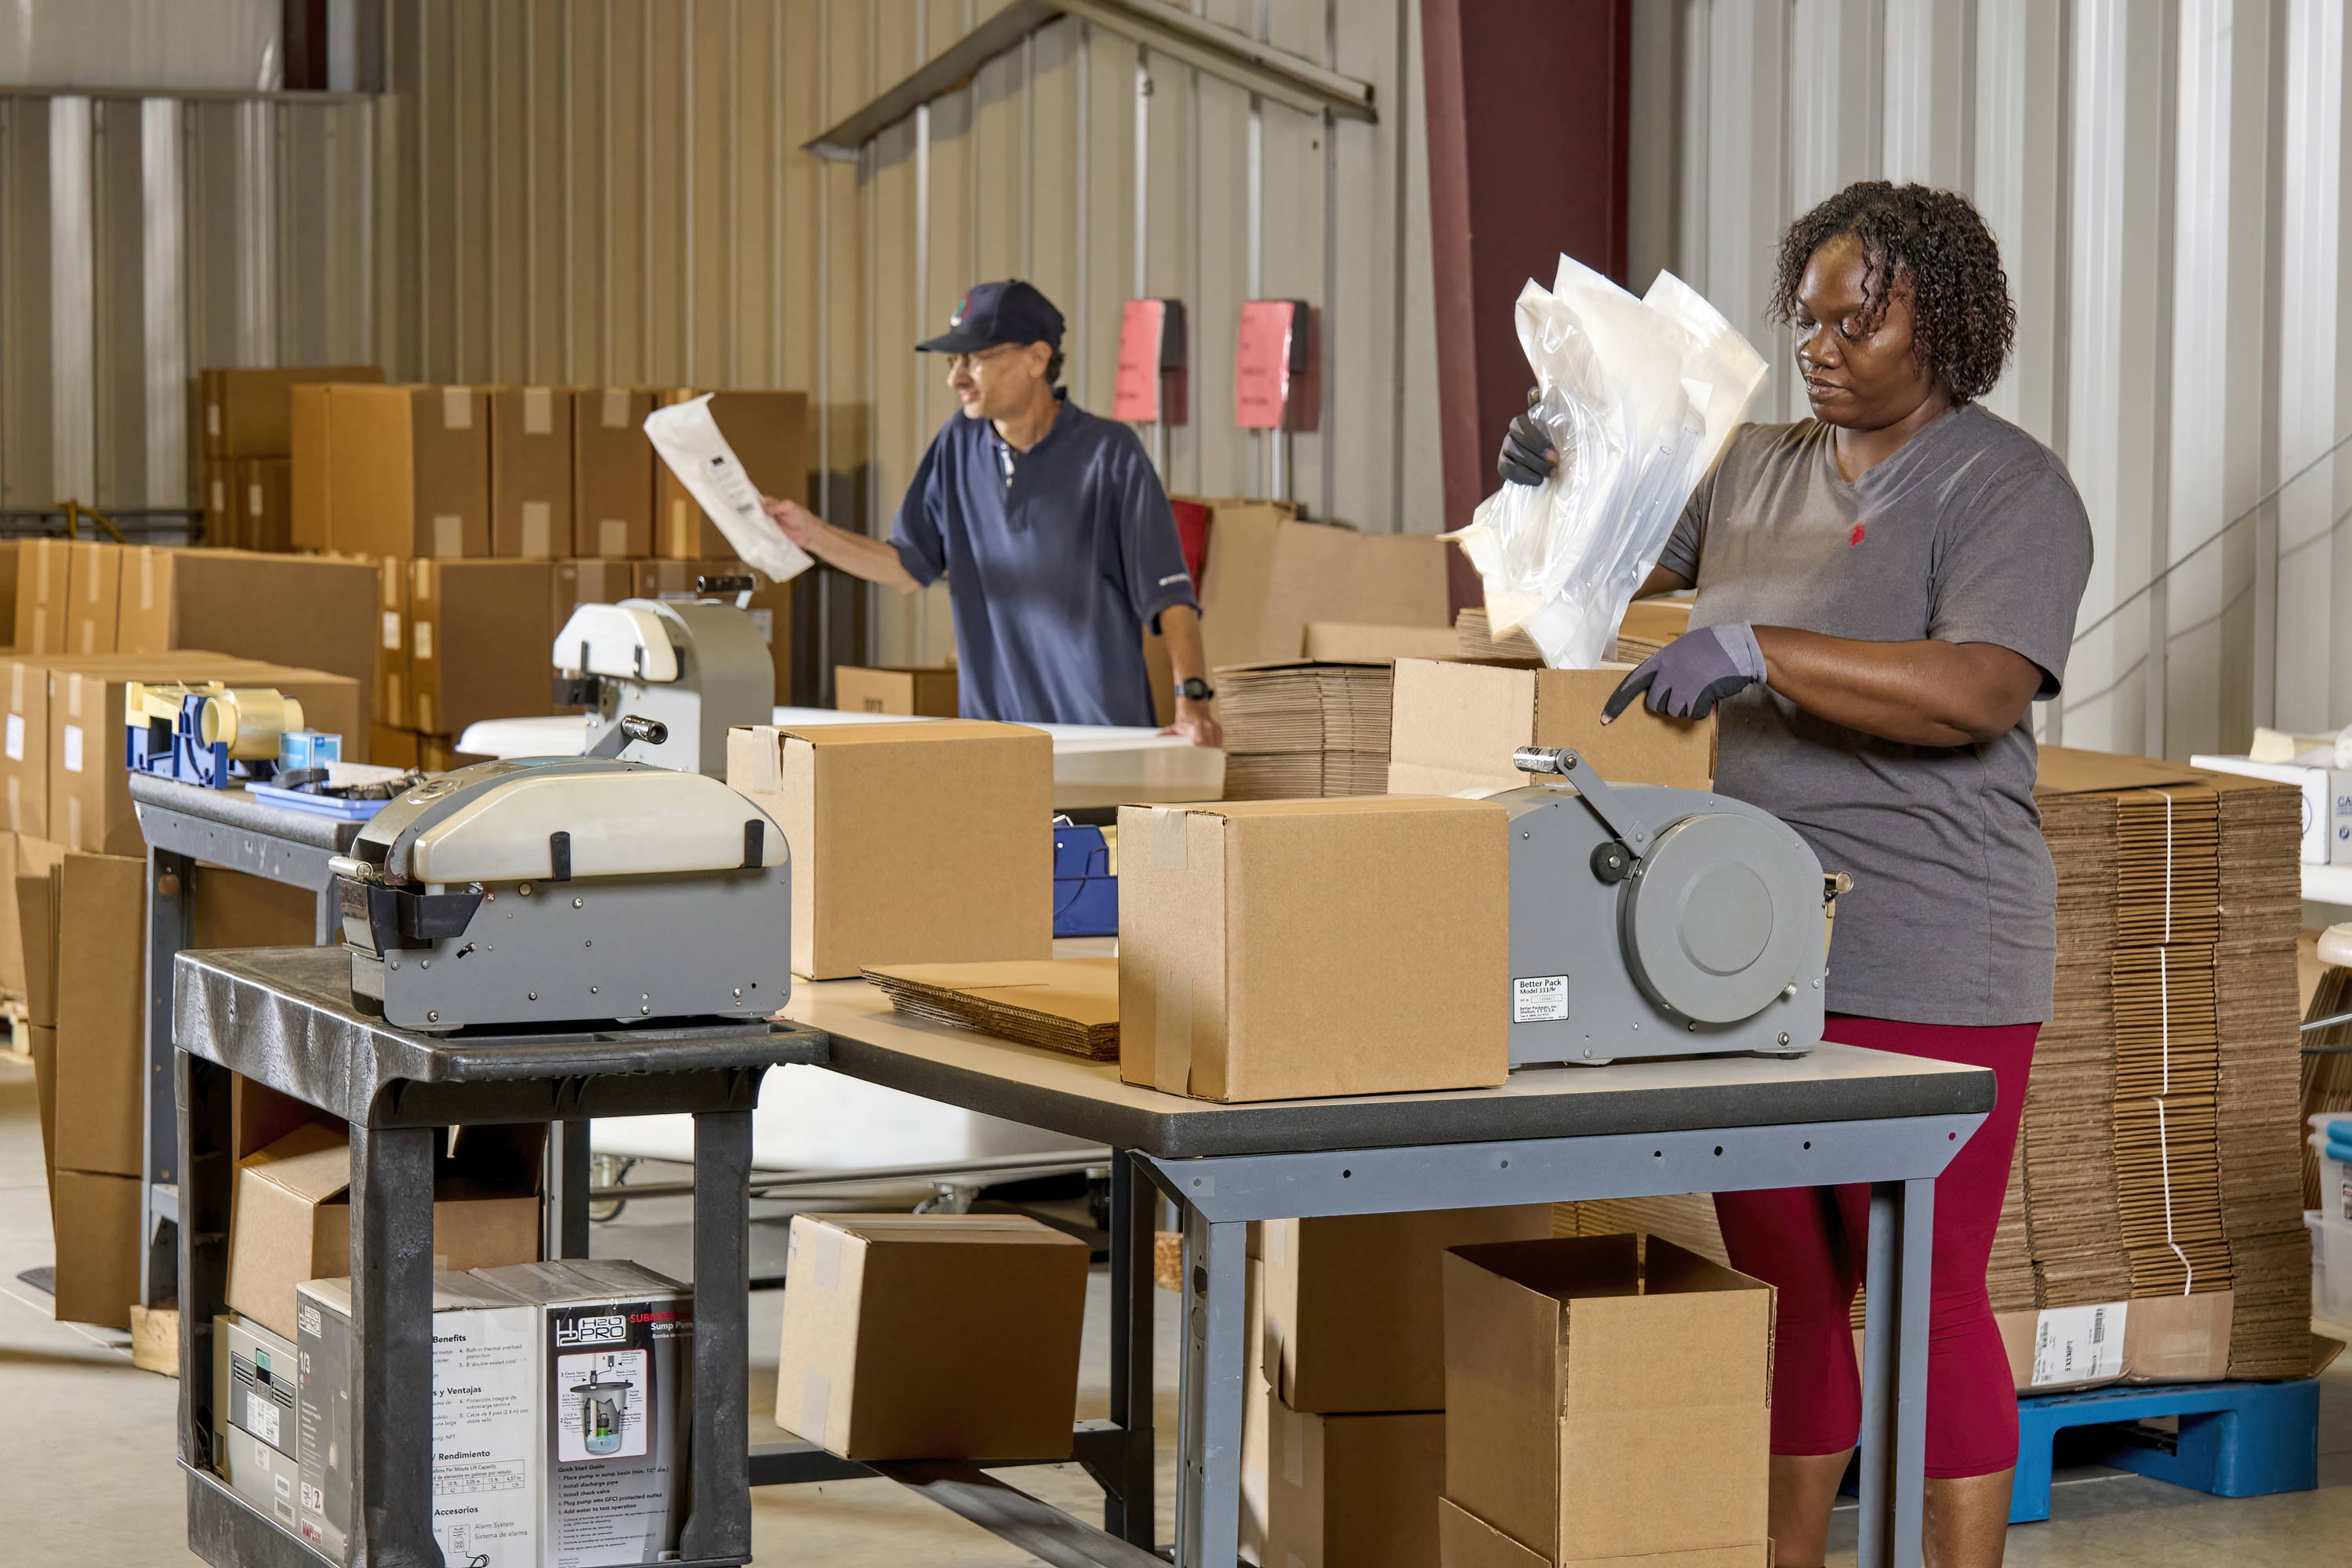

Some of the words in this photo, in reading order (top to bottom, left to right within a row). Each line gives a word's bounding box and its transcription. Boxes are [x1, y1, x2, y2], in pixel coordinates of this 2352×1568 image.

[583, 1318, 622, 1327] H2O
[651, 1322, 673, 1330] Sump
[433, 1334, 466, 1343] Benefits
[580, 1327, 623, 1340] PRO
[299, 1351, 310, 1374] 1/3
[447, 1385, 481, 1396] Ventajas
[438, 1450, 491, 1461] Rendimiento
[314, 1490, 321, 1508] 2
[434, 1505, 479, 1516] Accesorios
